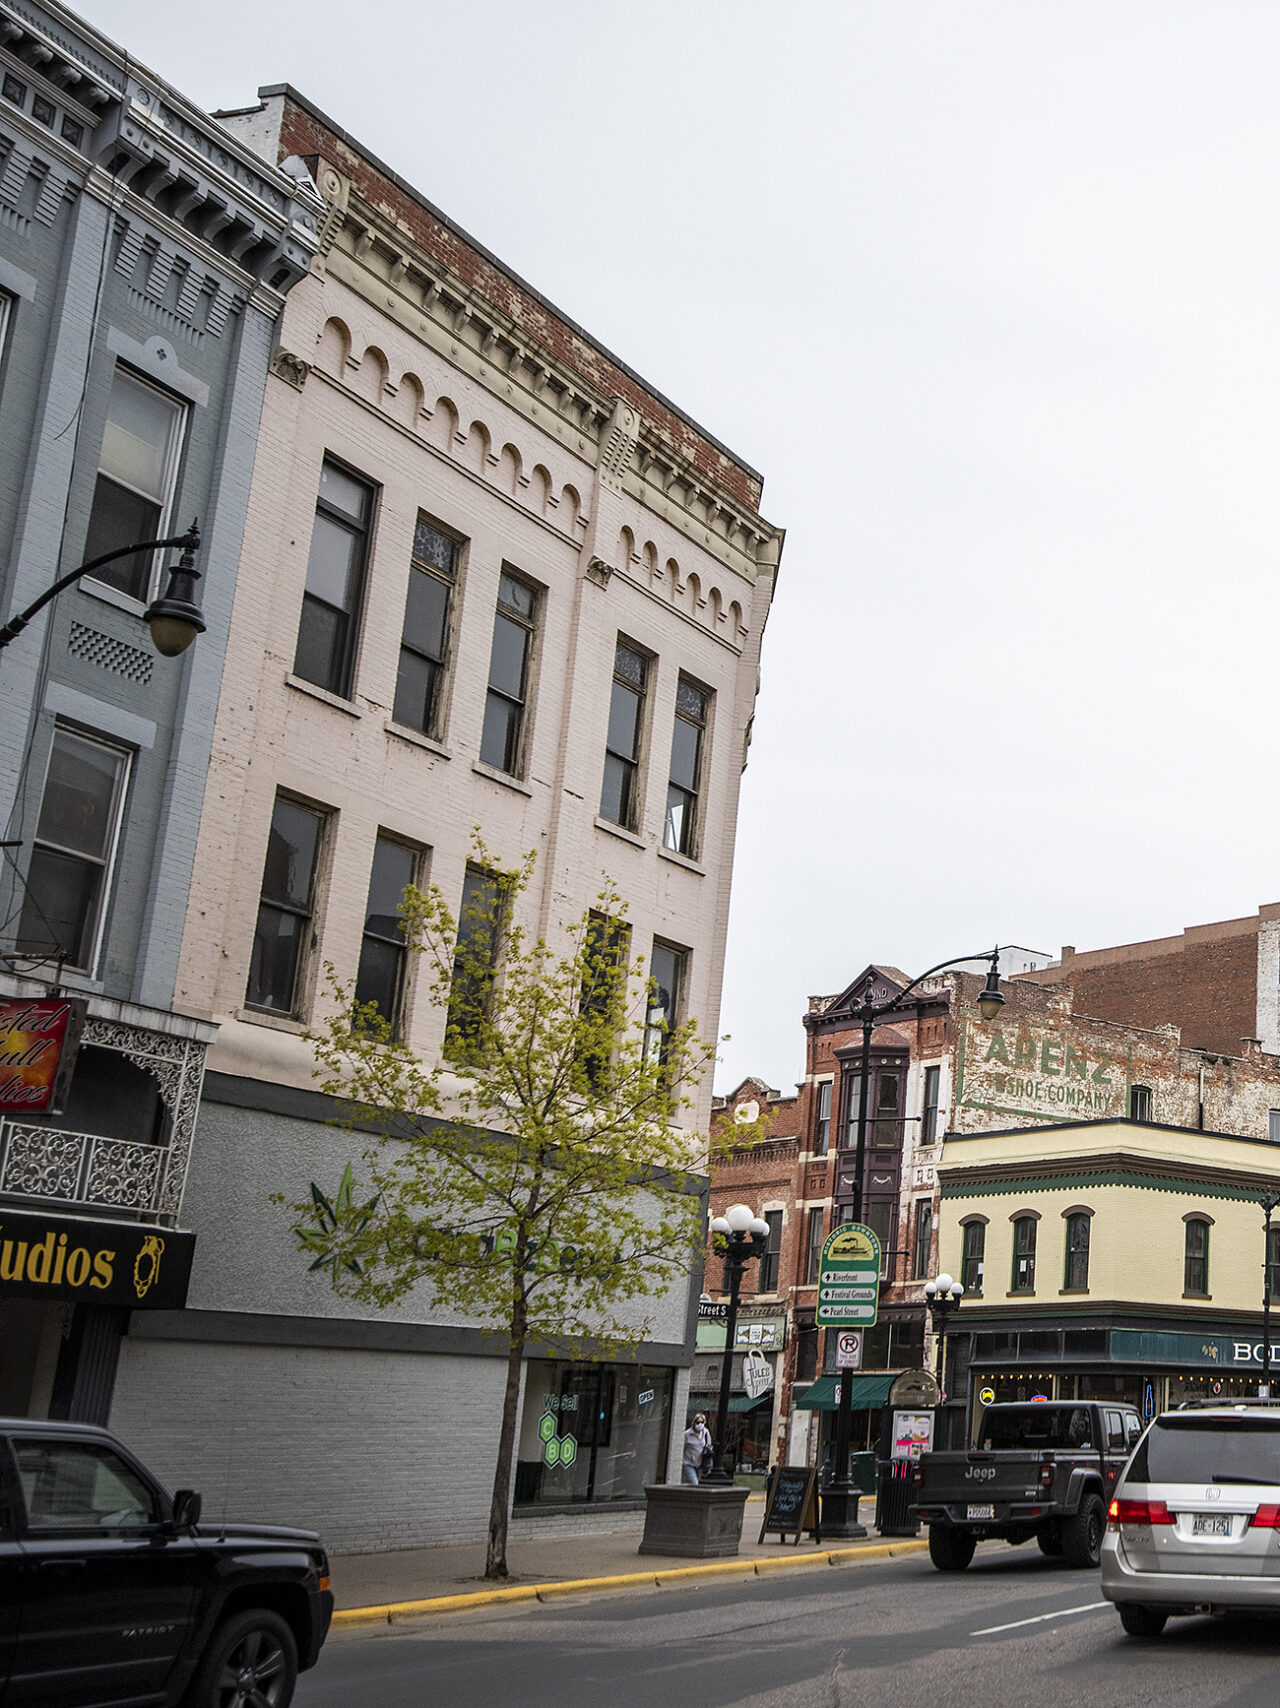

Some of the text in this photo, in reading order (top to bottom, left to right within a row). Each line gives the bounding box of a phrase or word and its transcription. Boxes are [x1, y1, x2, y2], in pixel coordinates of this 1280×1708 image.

[0, 1004, 71, 1035] sted
[0, 1038, 56, 1067] ull
[1007, 1076, 1113, 1112] SHOE COMPANY
[0, 1231, 116, 1290] udios
[832, 1272, 858, 1283] Riverfront
[831, 1289, 873, 1300] Festival Grounds
[830, 1306, 859, 1317] Pearl Street
[544, 1394, 579, 1411] We Sell
[639, 1390, 654, 1403] OPEN
[965, 1466, 996, 1479] Jeep
